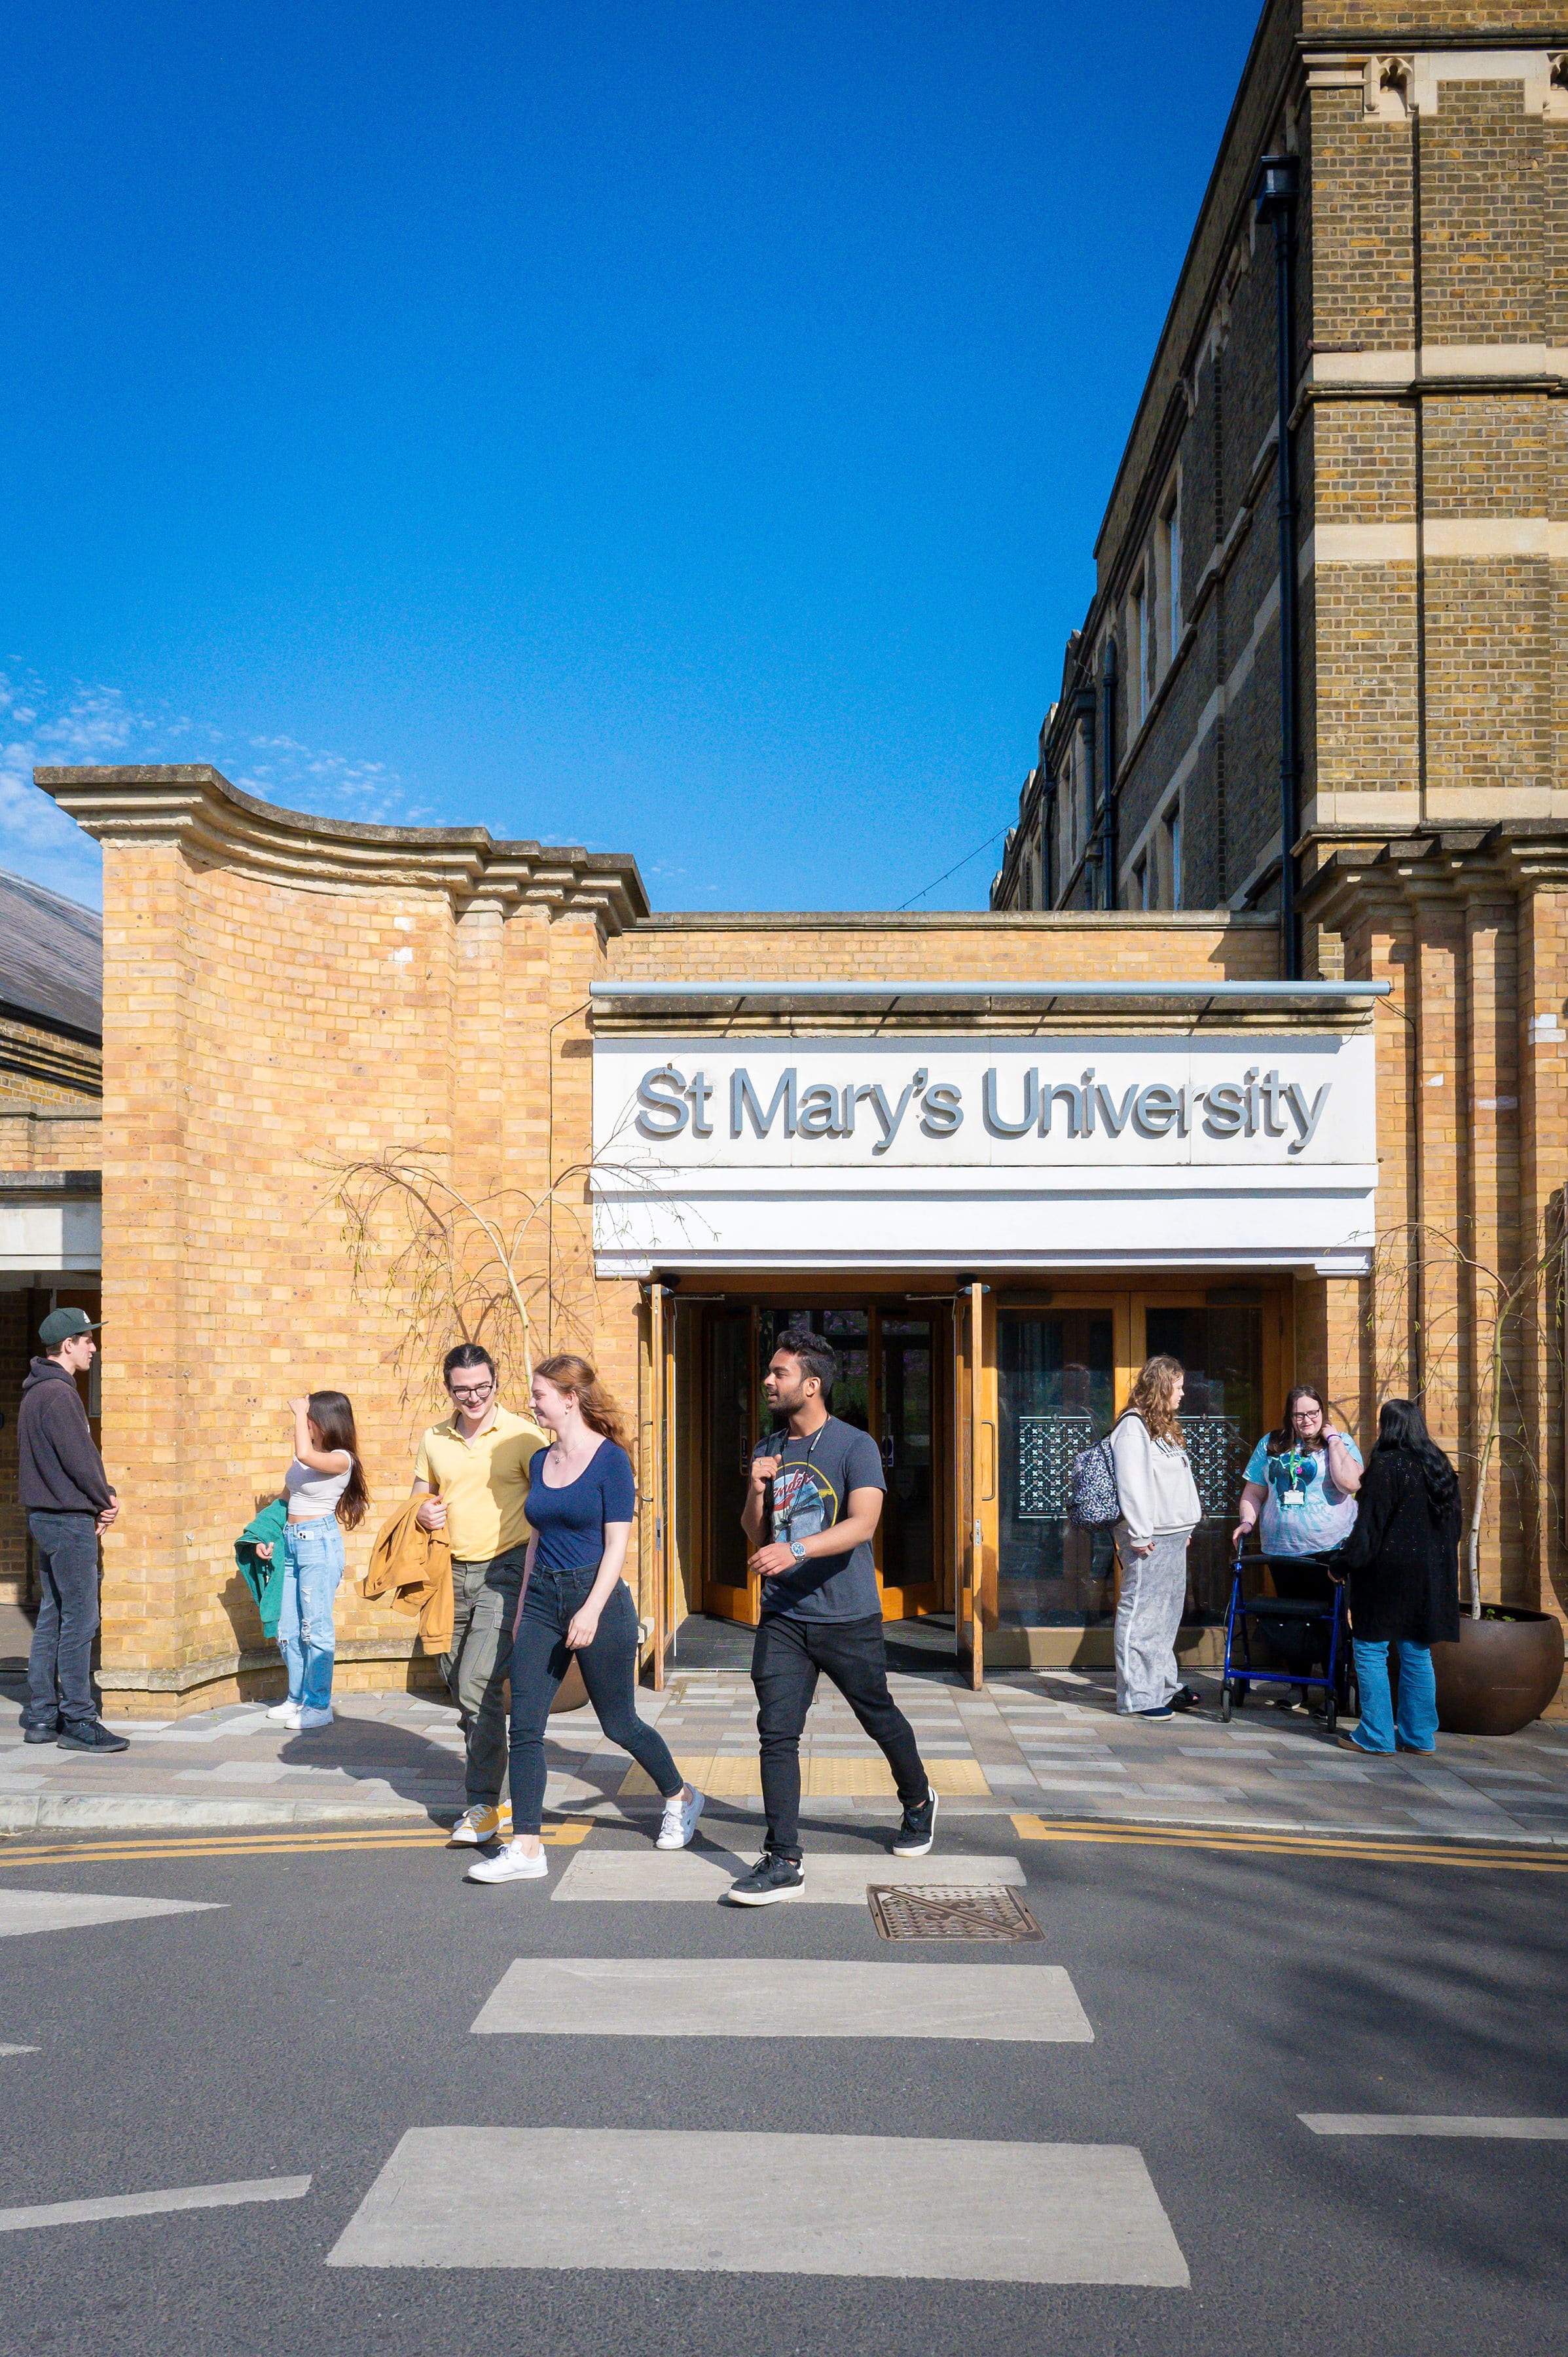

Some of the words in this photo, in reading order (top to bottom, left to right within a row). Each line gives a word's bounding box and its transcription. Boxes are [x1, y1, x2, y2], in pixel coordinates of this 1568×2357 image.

[637, 1066, 714, 1135] St
[731, 1067, 965, 1150] Mary’s
[985, 1066, 1333, 1150] University
